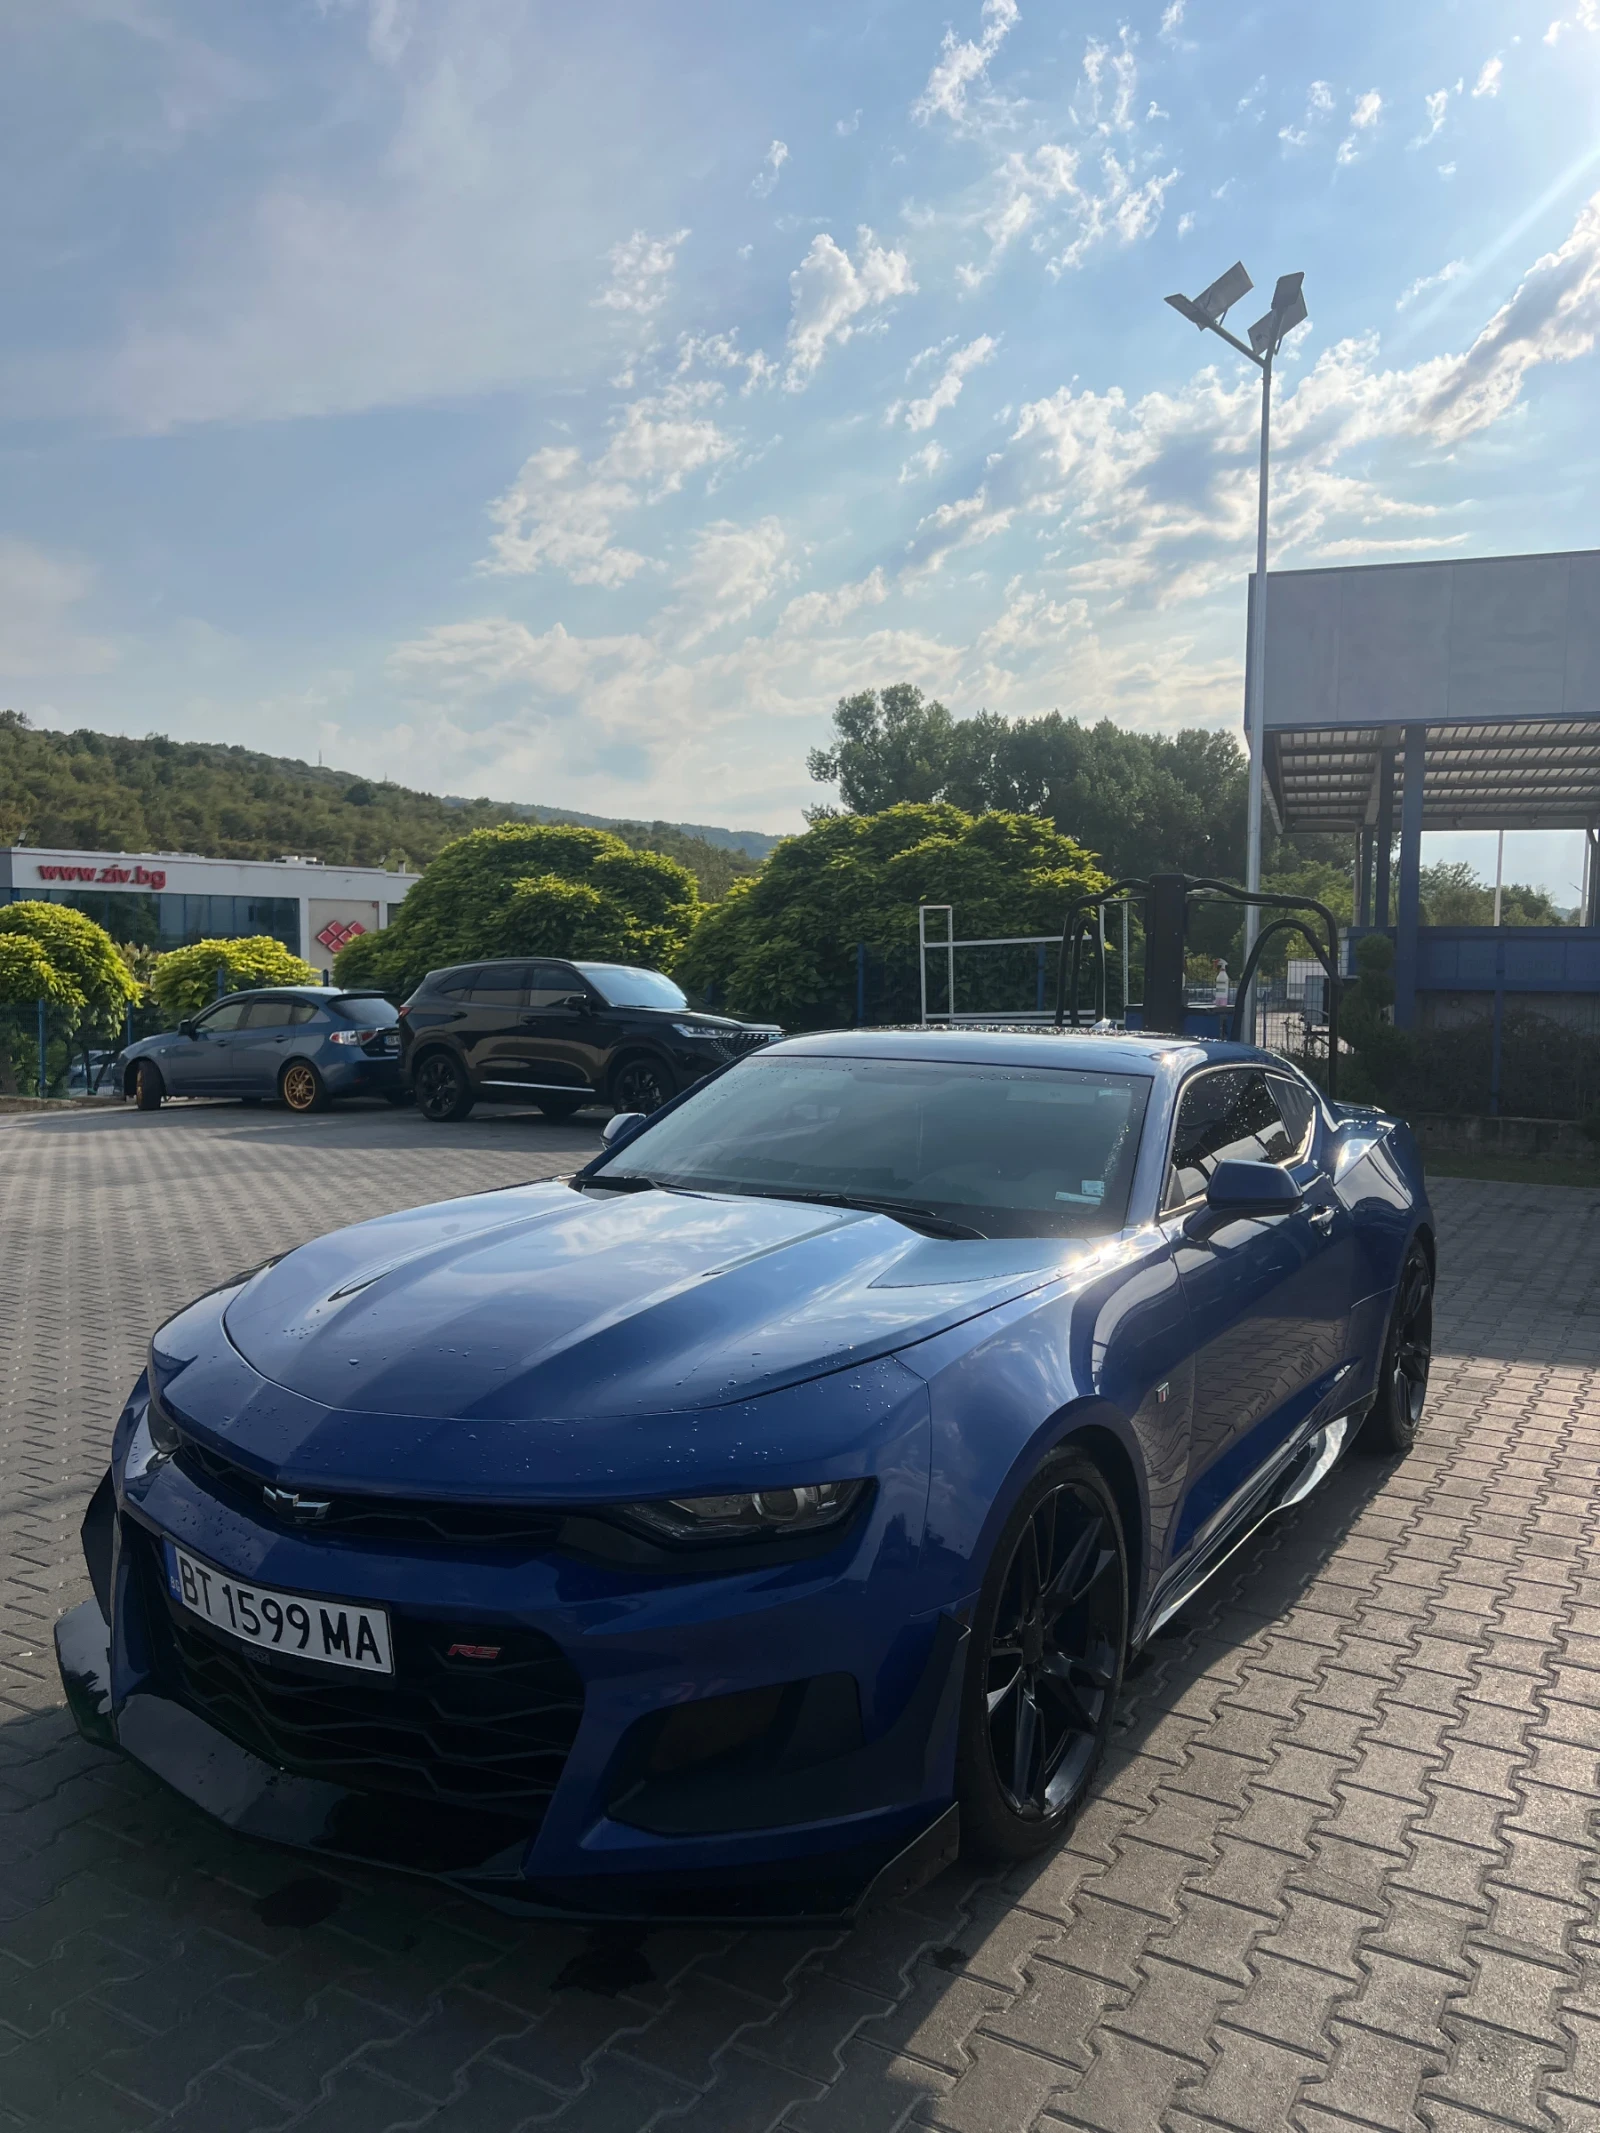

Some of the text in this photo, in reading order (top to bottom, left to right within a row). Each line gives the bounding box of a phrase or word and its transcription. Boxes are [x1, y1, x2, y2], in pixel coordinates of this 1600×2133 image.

[170, 1576, 181, 1593] BG
[179, 1556, 382, 1664] BT 1599 MA
[447, 1644, 501, 1659] RS
